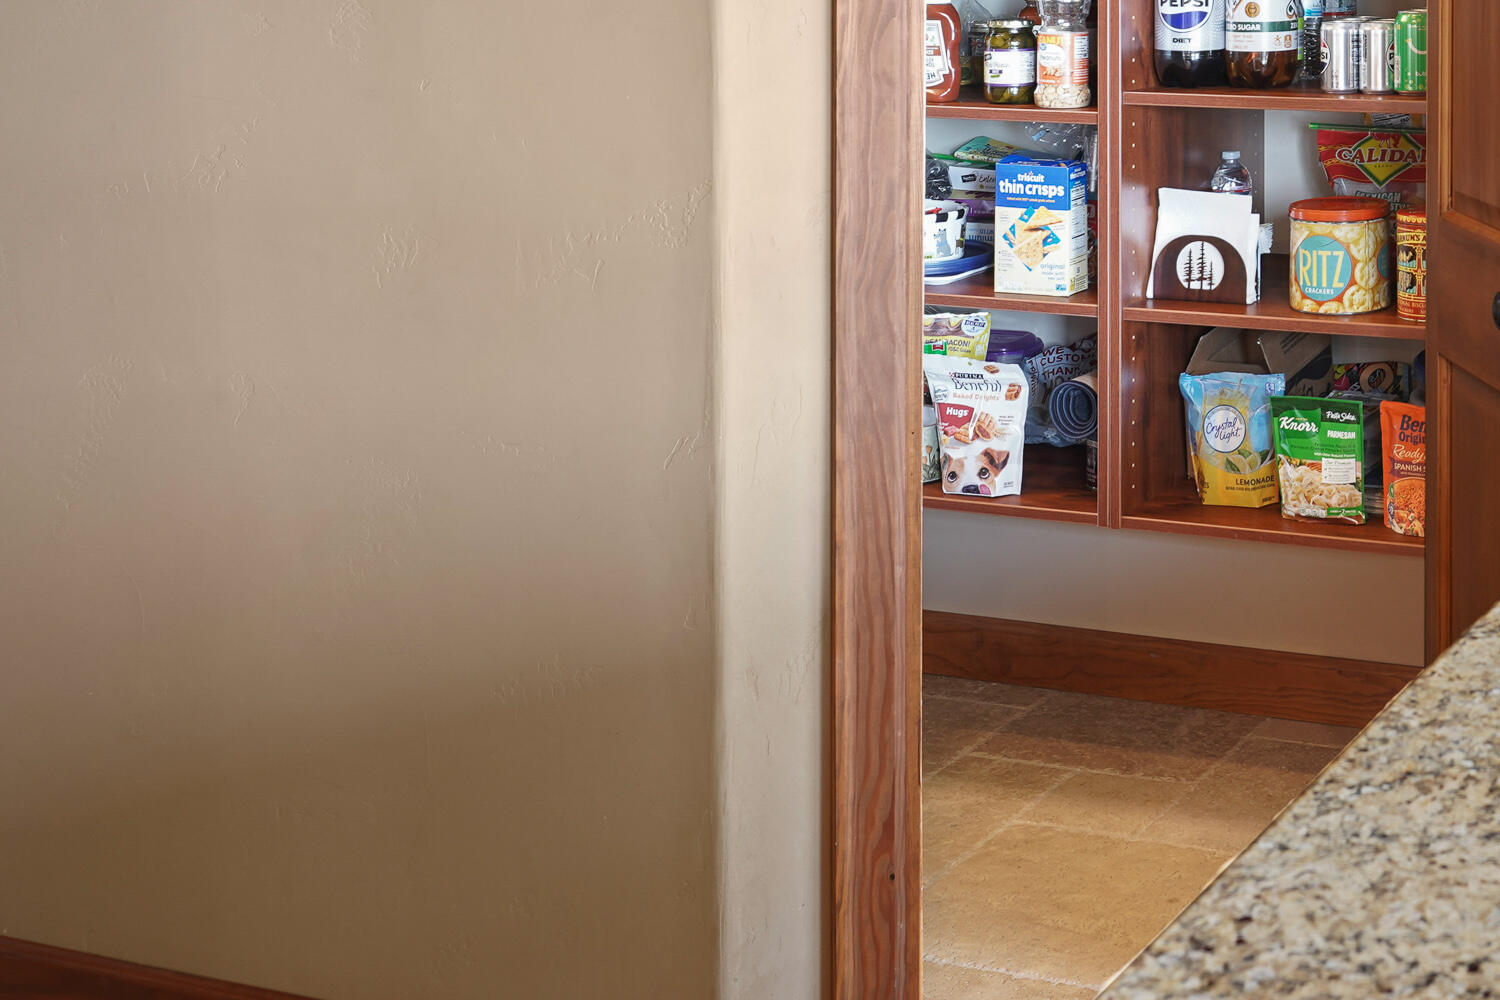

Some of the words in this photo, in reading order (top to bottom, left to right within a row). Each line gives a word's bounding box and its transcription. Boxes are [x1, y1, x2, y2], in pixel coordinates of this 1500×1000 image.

[1018, 172, 1045, 183] triscuit
[999, 179, 1025, 194] thin
[1025, 184, 1065, 198] crisps
[1299, 249, 1345, 288] RITZ
[1305, 287, 1334, 295] CRACKERS
[1042, 346, 1065, 357] WE
[954, 372, 984, 380] PURINA
[946, 406, 969, 418] Hugs
[1206, 417, 1237, 438] Crystal
[1279, 416, 1318, 432] Knorr
[1327, 430, 1356, 439] PARMESAN
[1235, 475, 1275, 487] LEMONADE
